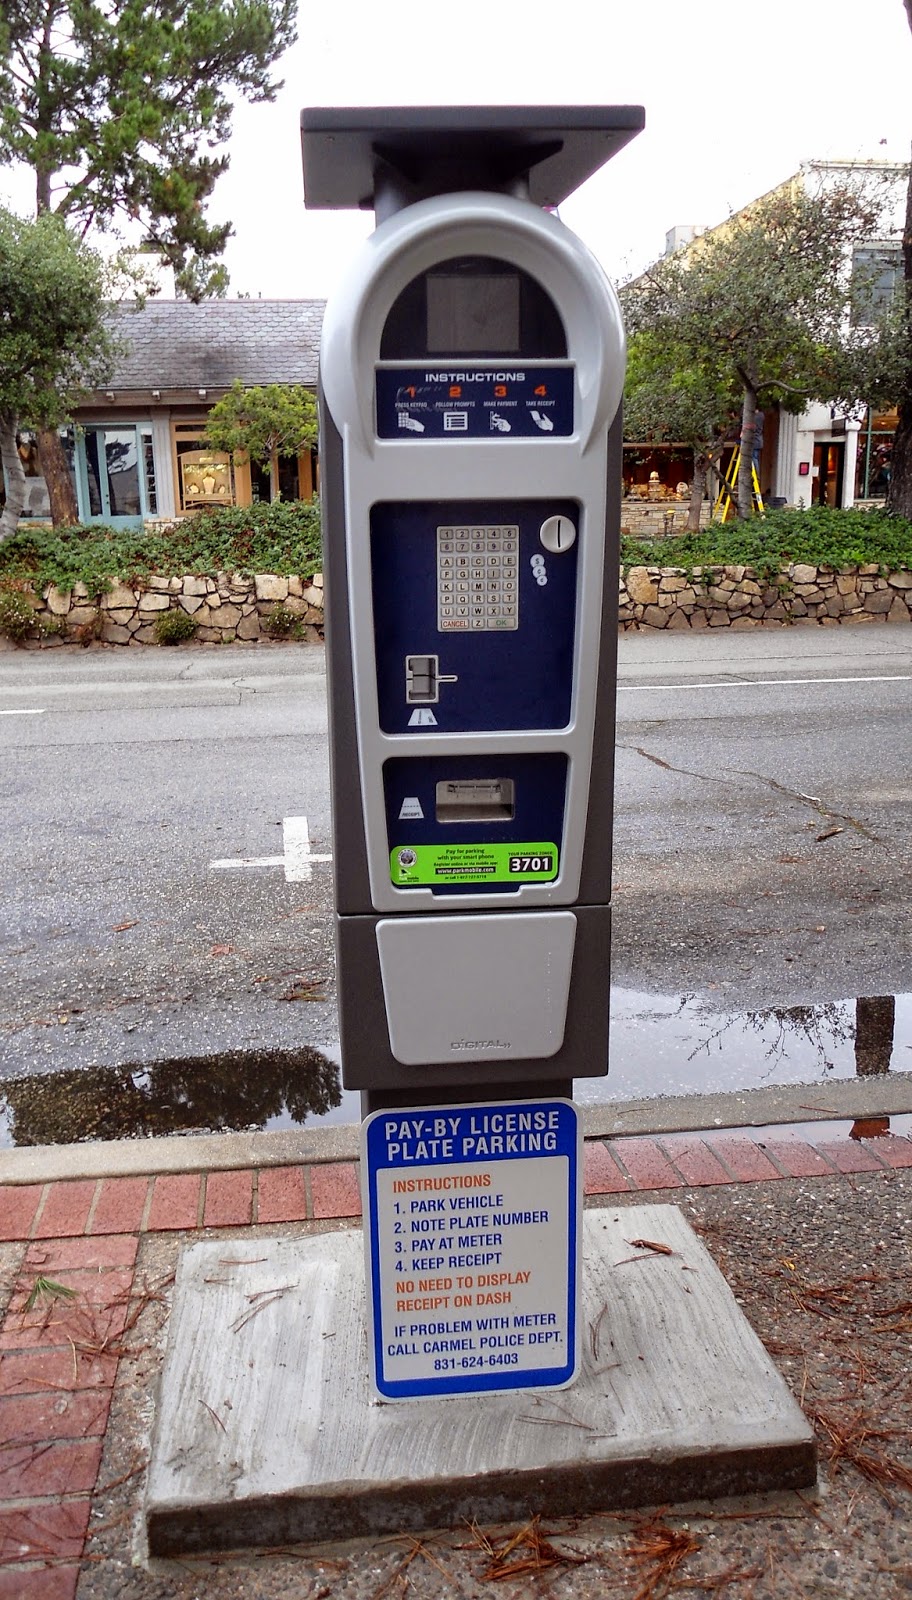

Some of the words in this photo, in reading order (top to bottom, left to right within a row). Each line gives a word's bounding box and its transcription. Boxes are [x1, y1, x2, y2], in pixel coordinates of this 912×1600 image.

[425, 373, 525, 382] INSTRUCTIONS
[405, 385, 416, 398] 1
[449, 385, 462, 398] 2
[494, 385, 507, 397] 3
[534, 384, 547, 397] 4
[511, 857, 549, 871] 3701
[385, 1117, 461, 1140] PAY-BY
[470, 1111, 559, 1135] LICENSE
[388, 1139, 453, 1161] PLATE
[463, 1132, 557, 1156] PARKING
[393, 1174, 491, 1193] INSTRUCTIONS
[394, 1202, 406, 1214] 1.
[410, 1199, 445, 1213] PARK
[449, 1194, 504, 1210] VEHICLE
[394, 1222, 406, 1234] 2.
[411, 1219, 445, 1232] NOTE
[449, 1215, 489, 1230] PLATE
[493, 1210, 549, 1226] NUMBER
[395, 1241, 407, 1253] 3.
[412, 1238, 435, 1252] PAY
[439, 1237, 454, 1250] AT
[458, 1233, 502, 1248] METER
[395, 1260, 407, 1272] 4.
[412, 1257, 444, 1271] KEEP
[449, 1252, 502, 1268] RECEIPT
[396, 1281, 414, 1294] NO
[419, 1277, 452, 1292] NEED
[456, 1276, 473, 1289] TO
[477, 1271, 531, 1287] DISPLAY
[396, 1297, 450, 1312] RECEIPT
[454, 1295, 472, 1307] ON
[476, 1292, 511, 1306] DASH
[394, 1325, 406, 1337] IF
[410, 1320, 472, 1336] PROBLEM
[476, 1317, 509, 1331] WITH
[513, 1313, 556, 1327] METER
[388, 1343, 419, 1356] CALL
[424, 1338, 476, 1354] CARMEL
[480, 1334, 524, 1349] POLICE
[528, 1331, 563, 1345] DEPT.
[434, 1353, 519, 1371] 831-624-6403
